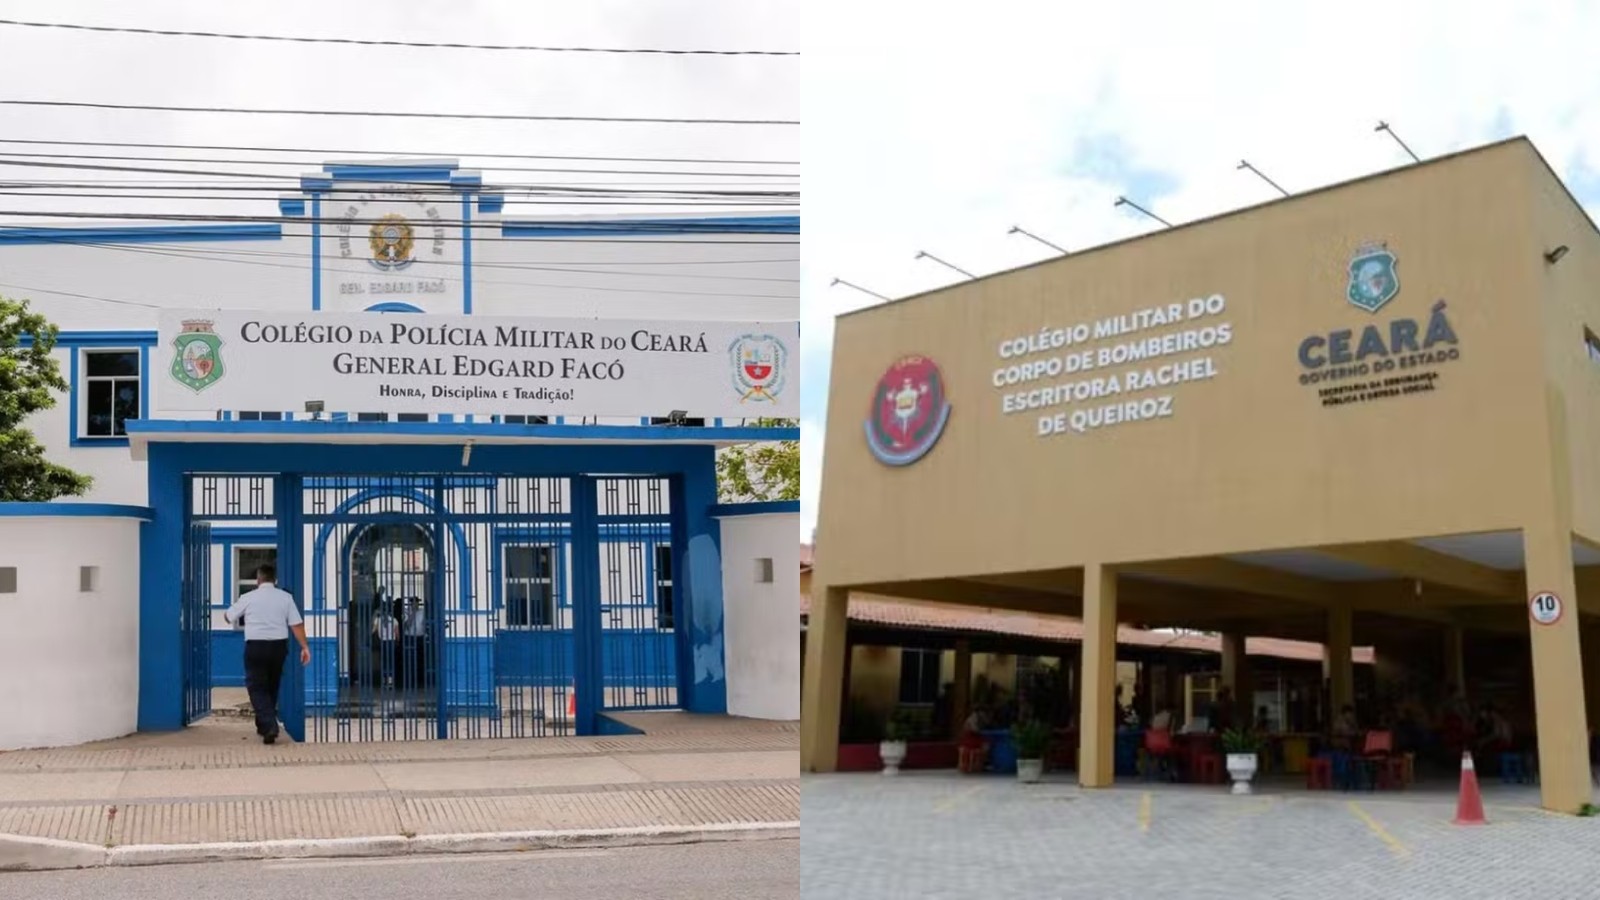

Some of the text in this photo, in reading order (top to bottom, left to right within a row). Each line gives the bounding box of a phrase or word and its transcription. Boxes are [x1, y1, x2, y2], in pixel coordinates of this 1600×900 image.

[336, 205, 359, 258] COLÉIO
[425, 206, 447, 257] MIITAR
[240, 321, 708, 353] COLÉGIO DA POLÍCIA MILITAR DO CEARÁ
[999, 293, 1226, 359] COLÉGIO MILITAR DO
[1298, 299, 1459, 370] CEARÁ
[333, 352, 625, 380] GENERAL EDGARD FACÓ
[992, 323, 1233, 388] CORPO DE BOMBEIROS
[1298, 348, 1460, 386] GOVERNO DO ESTADO
[1002, 357, 1218, 413] ESCRITORA RACHEL
[1318, 383, 1368, 399] SECRETARIA
[1370, 380, 1383, 390] DA
[1037, 397, 1174, 436] DE QUEIROZ
[1535, 595, 1556, 612] 10
